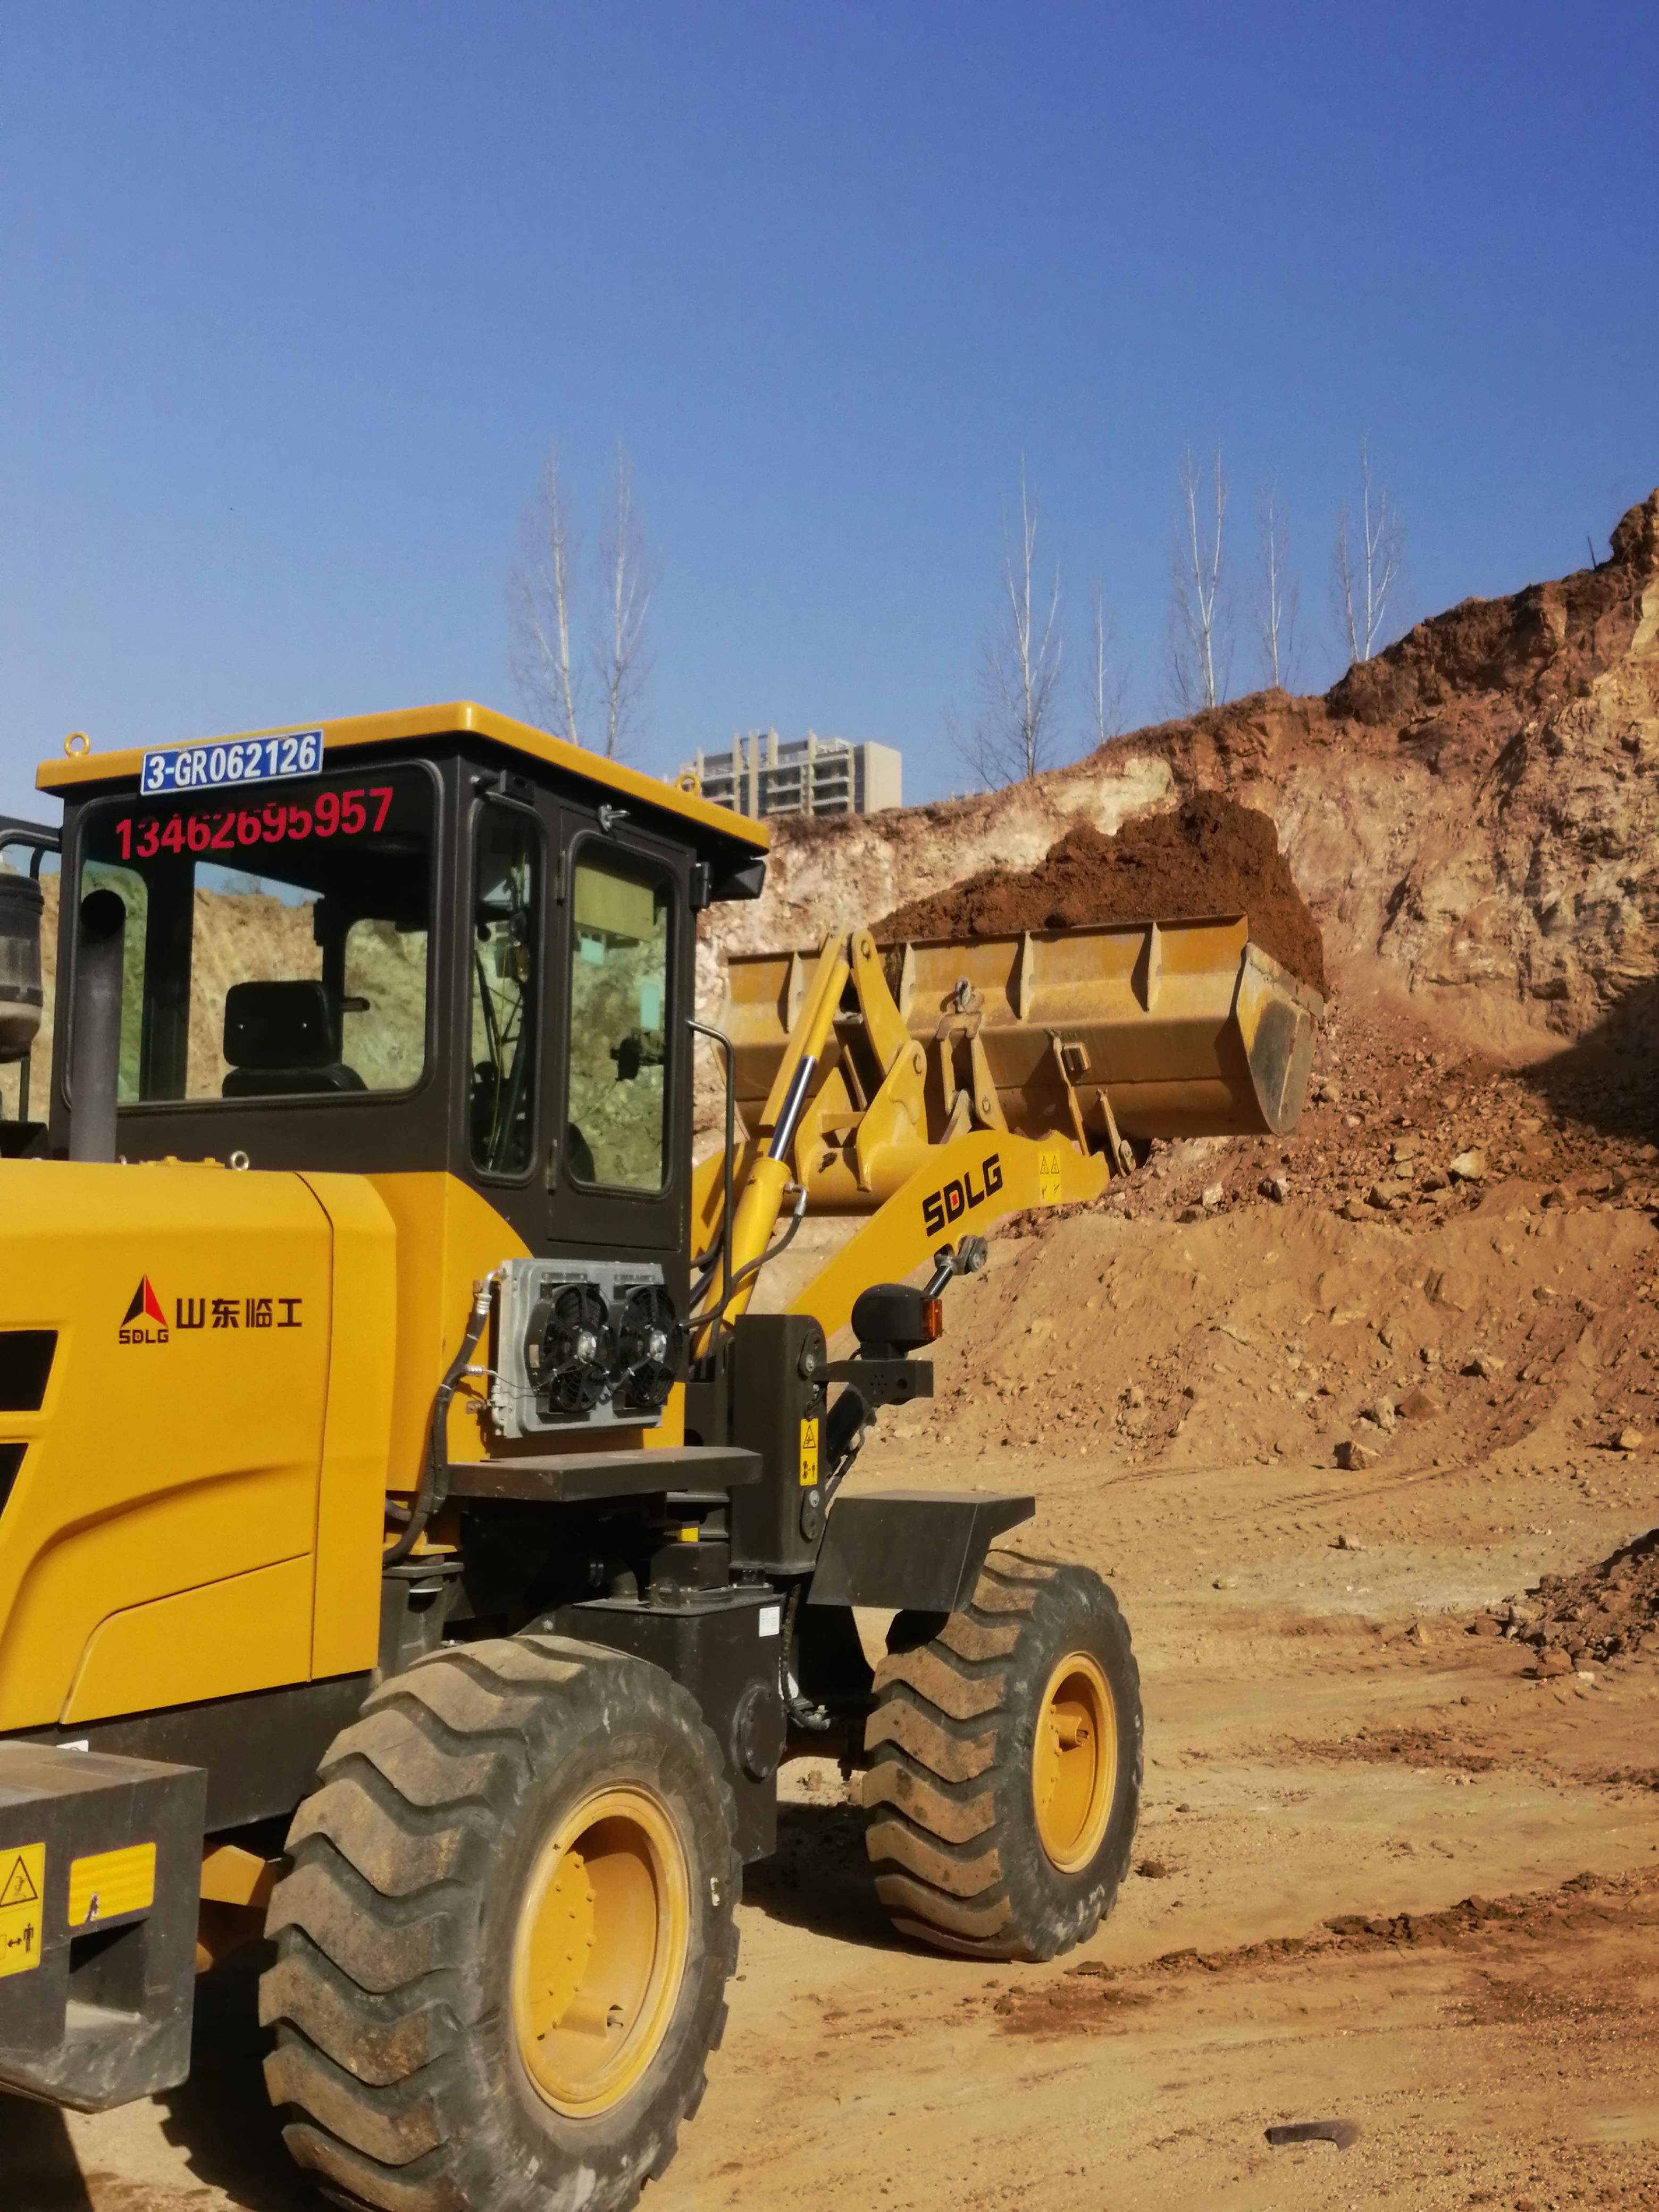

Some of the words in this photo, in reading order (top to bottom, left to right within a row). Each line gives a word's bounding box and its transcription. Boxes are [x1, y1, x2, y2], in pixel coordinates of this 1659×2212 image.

[147, 735, 316, 790] 3-GR062126
[116, 787, 393, 860] 13462695957
[922, 1152, 1003, 1237] SDLG
[119, 1329, 169, 1344] SDLG
[176, 1298, 303, 1329] 山东临工
